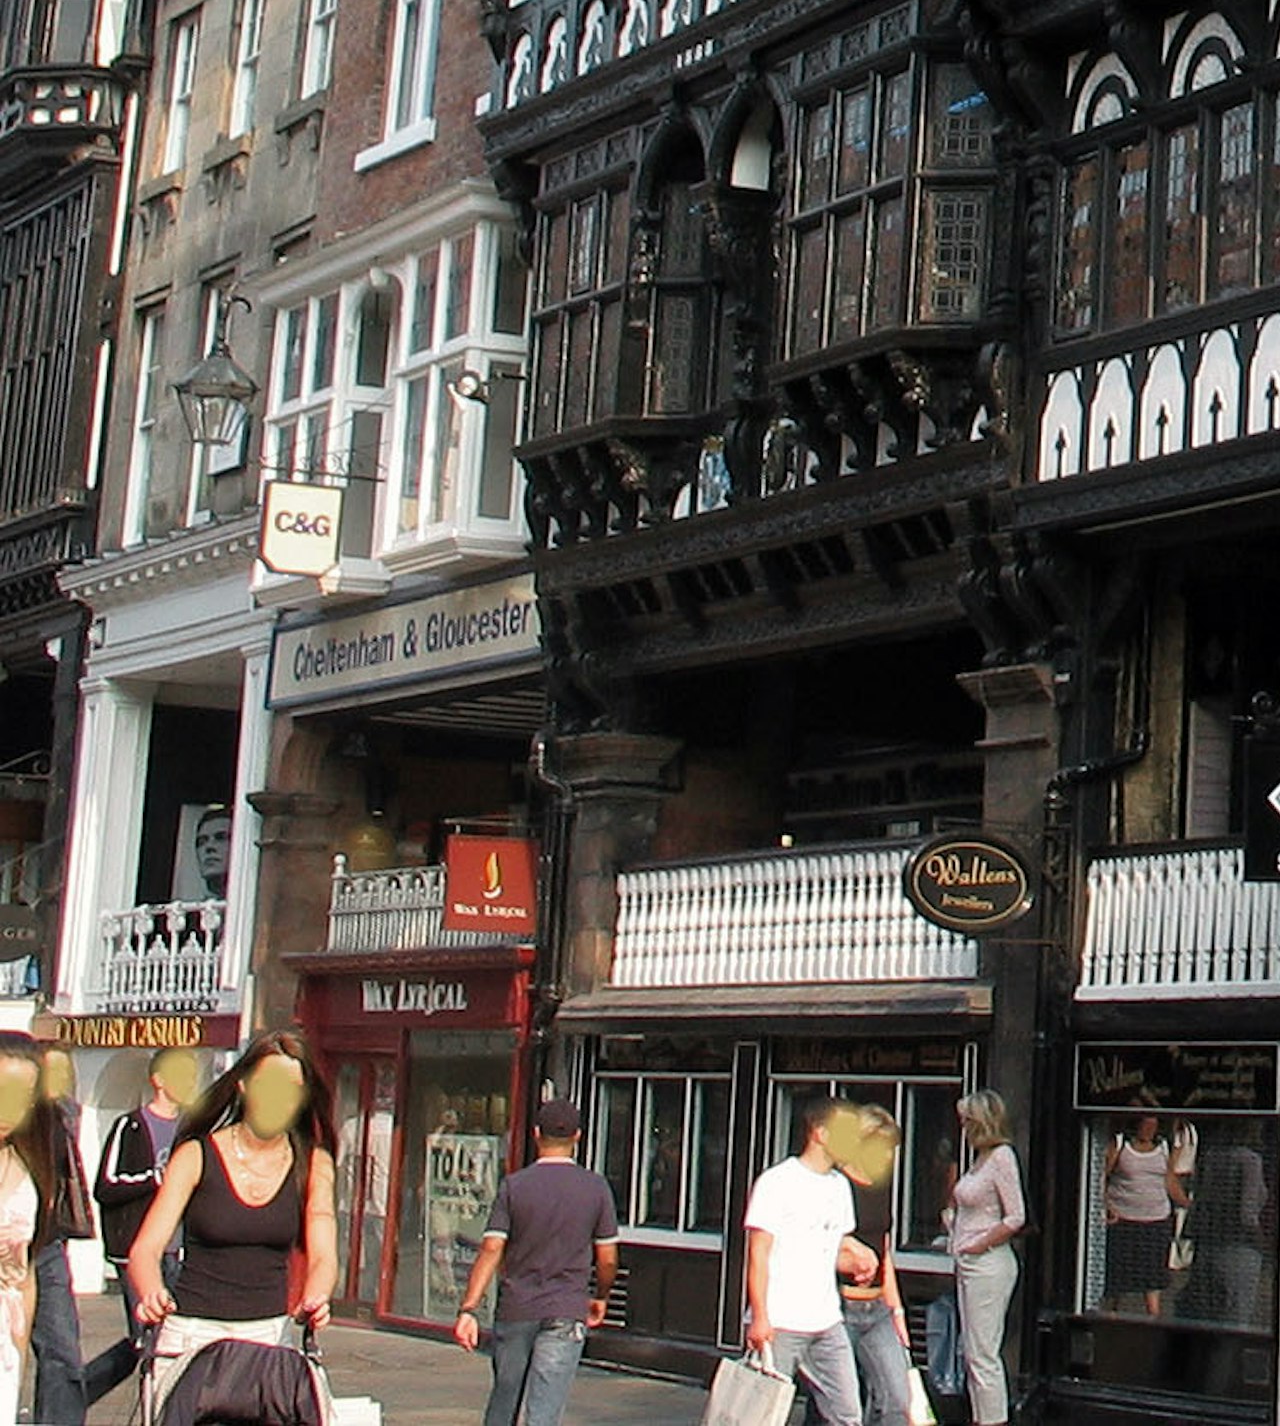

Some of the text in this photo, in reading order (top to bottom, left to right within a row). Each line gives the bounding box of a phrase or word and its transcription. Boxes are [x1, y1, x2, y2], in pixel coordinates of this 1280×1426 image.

[274, 509, 331, 537] C&G
[294, 599, 532, 681] Cheltenham & Gloucester
[926, 853, 1018, 886] Waltons
[57, 1015, 202, 1047] COUNTRY CASUALS
